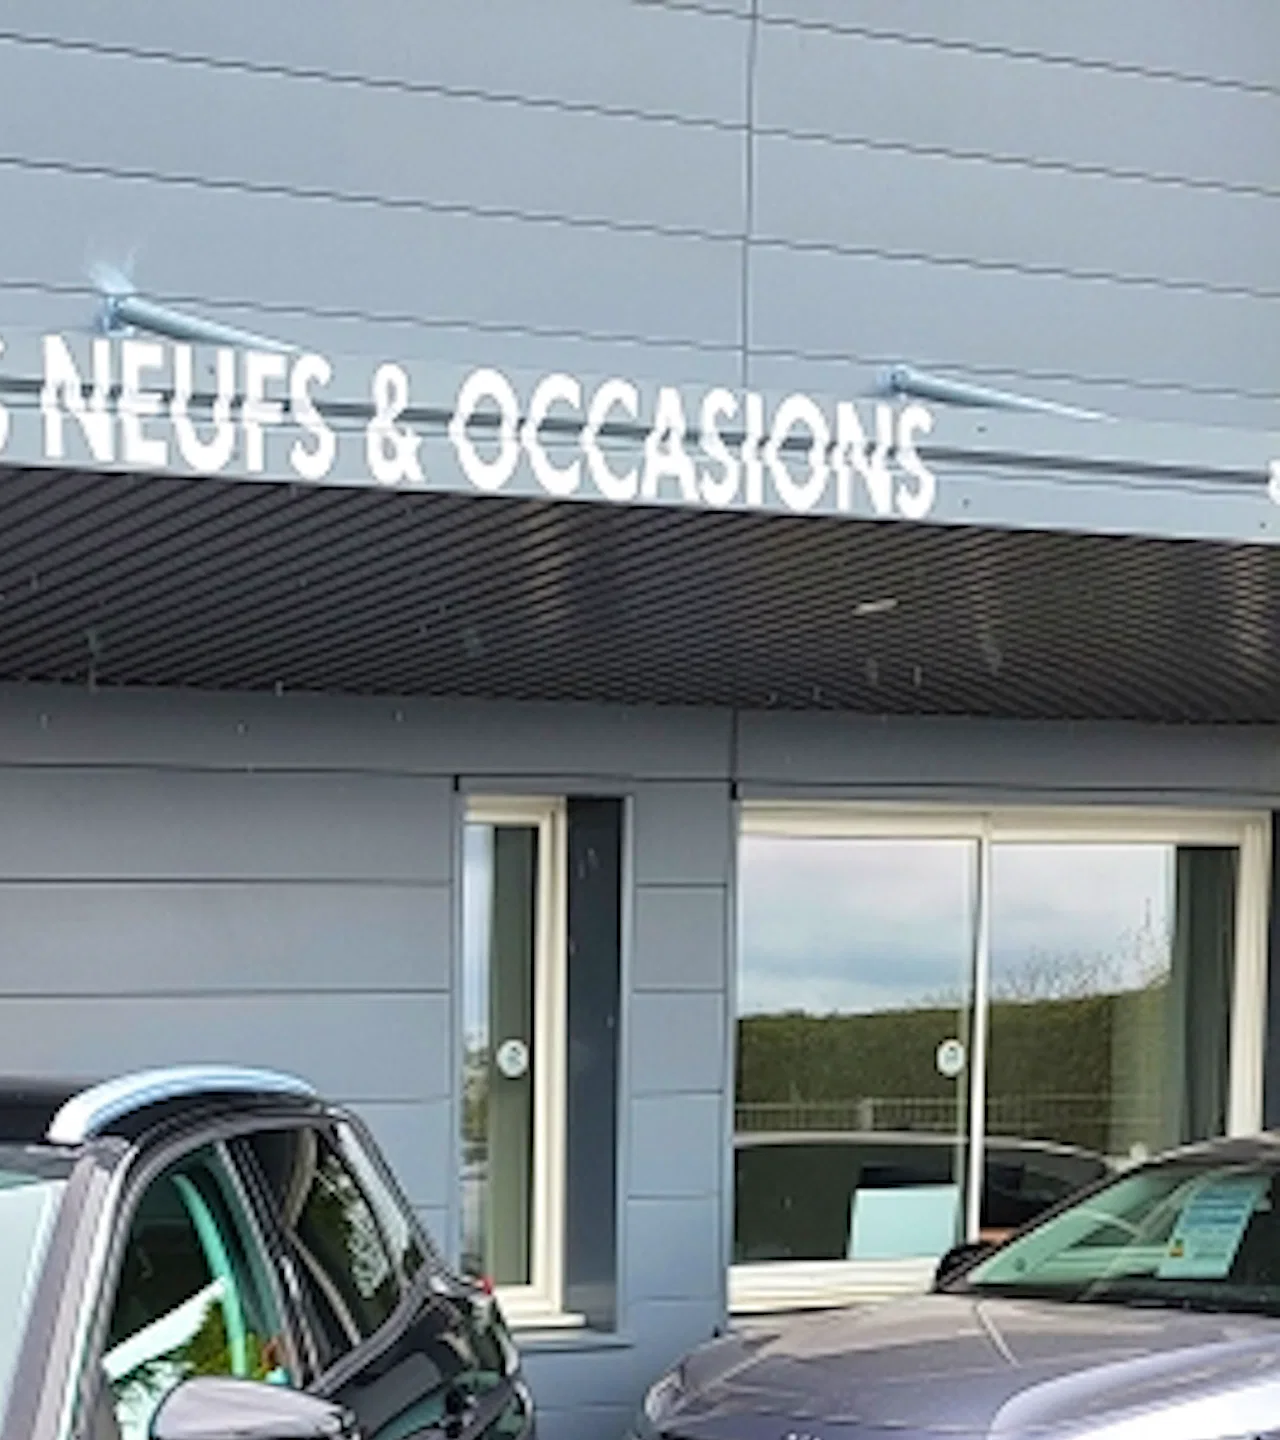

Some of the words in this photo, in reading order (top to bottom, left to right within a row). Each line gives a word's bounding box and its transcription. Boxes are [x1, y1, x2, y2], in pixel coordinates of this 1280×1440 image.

[41, 333, 336, 481] NEUFS
[365, 363, 427, 484] &
[448, 368, 935, 520] OCCASIONS
